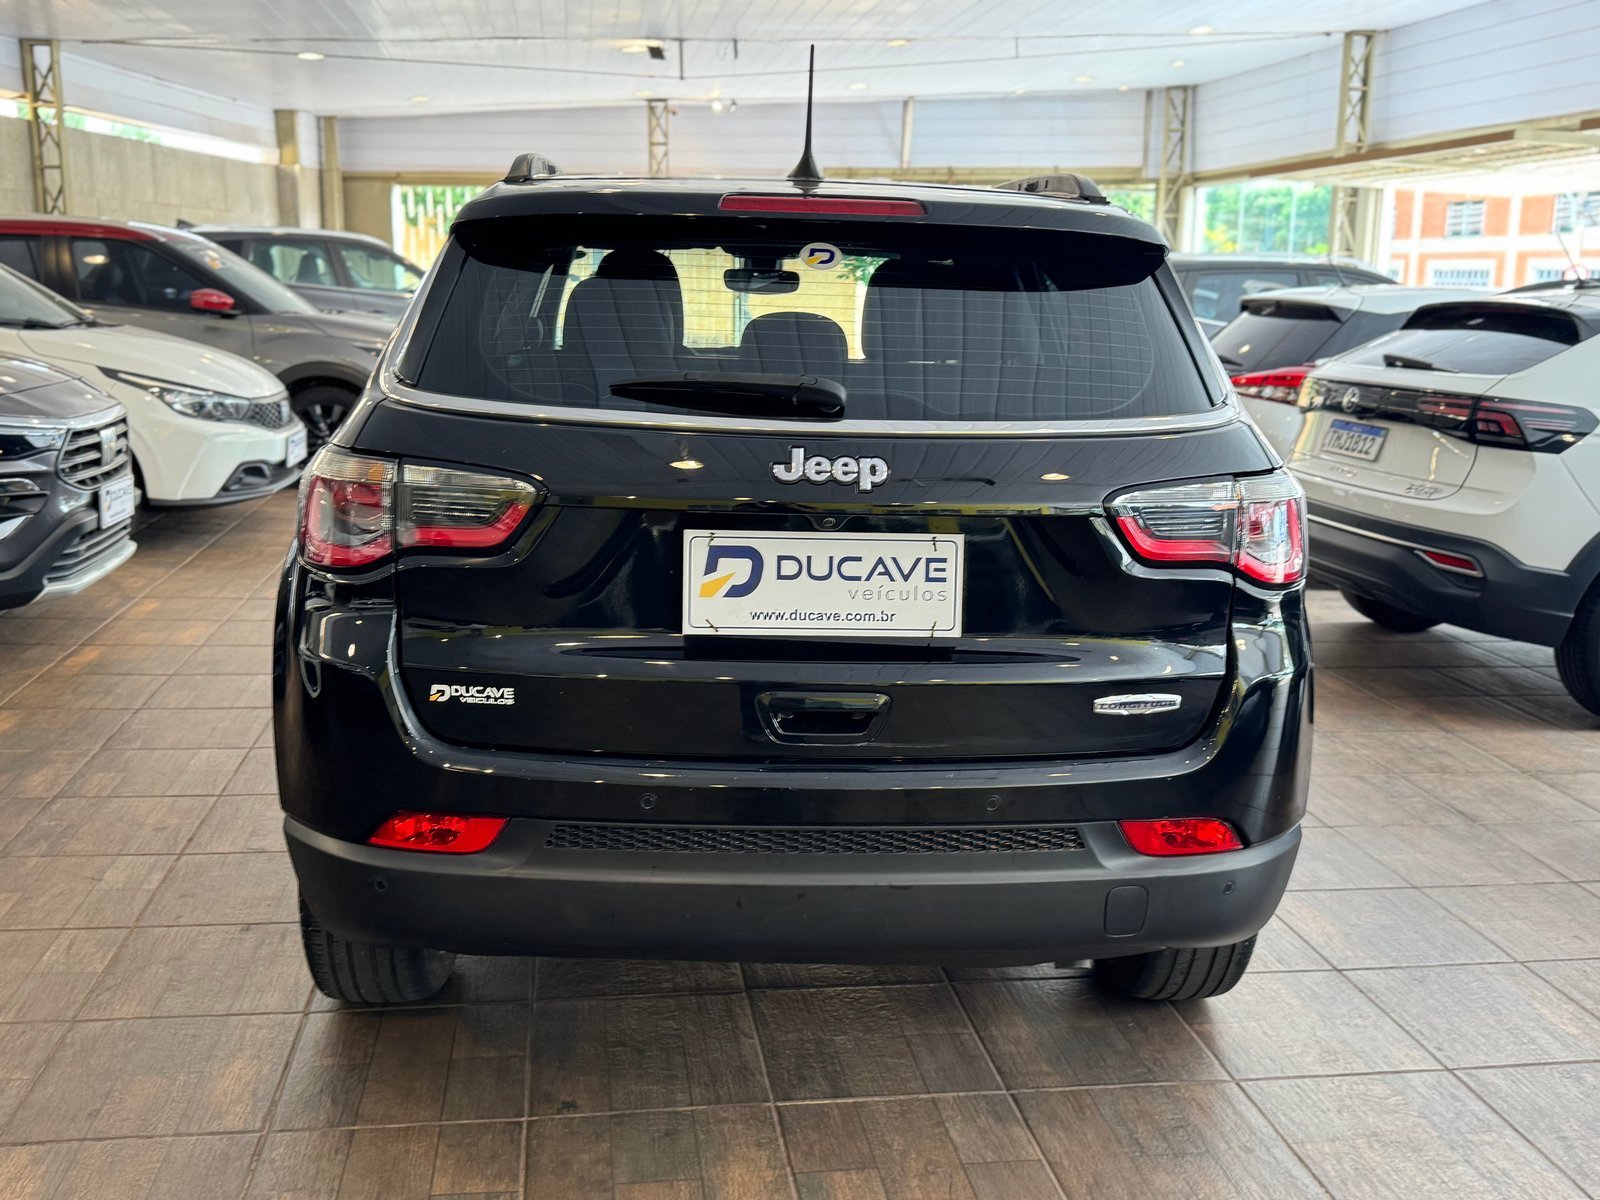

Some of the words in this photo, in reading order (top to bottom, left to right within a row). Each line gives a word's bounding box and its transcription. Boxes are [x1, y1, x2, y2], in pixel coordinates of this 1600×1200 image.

[770, 446, 889, 492] Jeep
[776, 555, 948, 583] DUCAVE
[848, 585, 948, 602] veículos
[749, 609, 897, 623] www.ducave.com.br
[451, 685, 515, 698] DUCAVE
